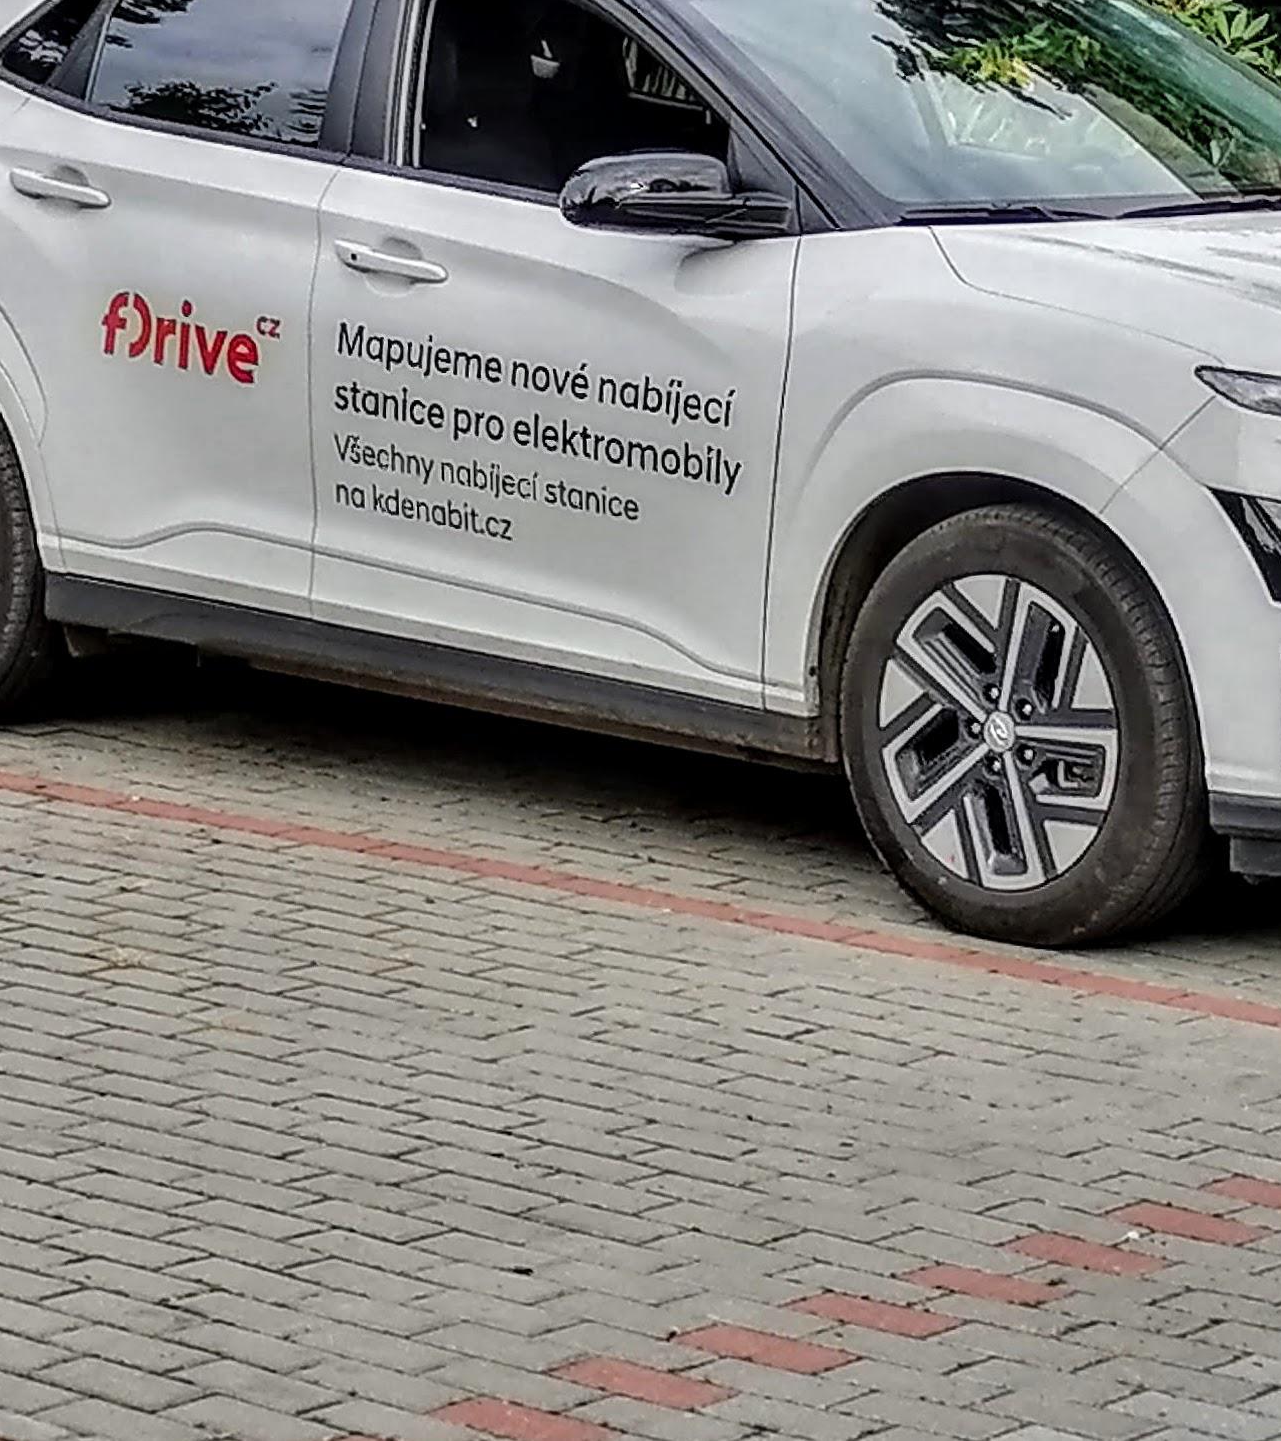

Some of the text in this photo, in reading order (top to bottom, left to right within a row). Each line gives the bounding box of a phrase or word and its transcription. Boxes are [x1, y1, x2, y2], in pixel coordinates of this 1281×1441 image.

[337, 322, 737, 428] Mapujeme nové nabíjecí
[333, 381, 743, 496] stanice pro elektromobily
[333, 433, 435, 486] Všechny
[544, 479, 640, 521] stanice
[335, 483, 514, 541] na kdenabit.cz
